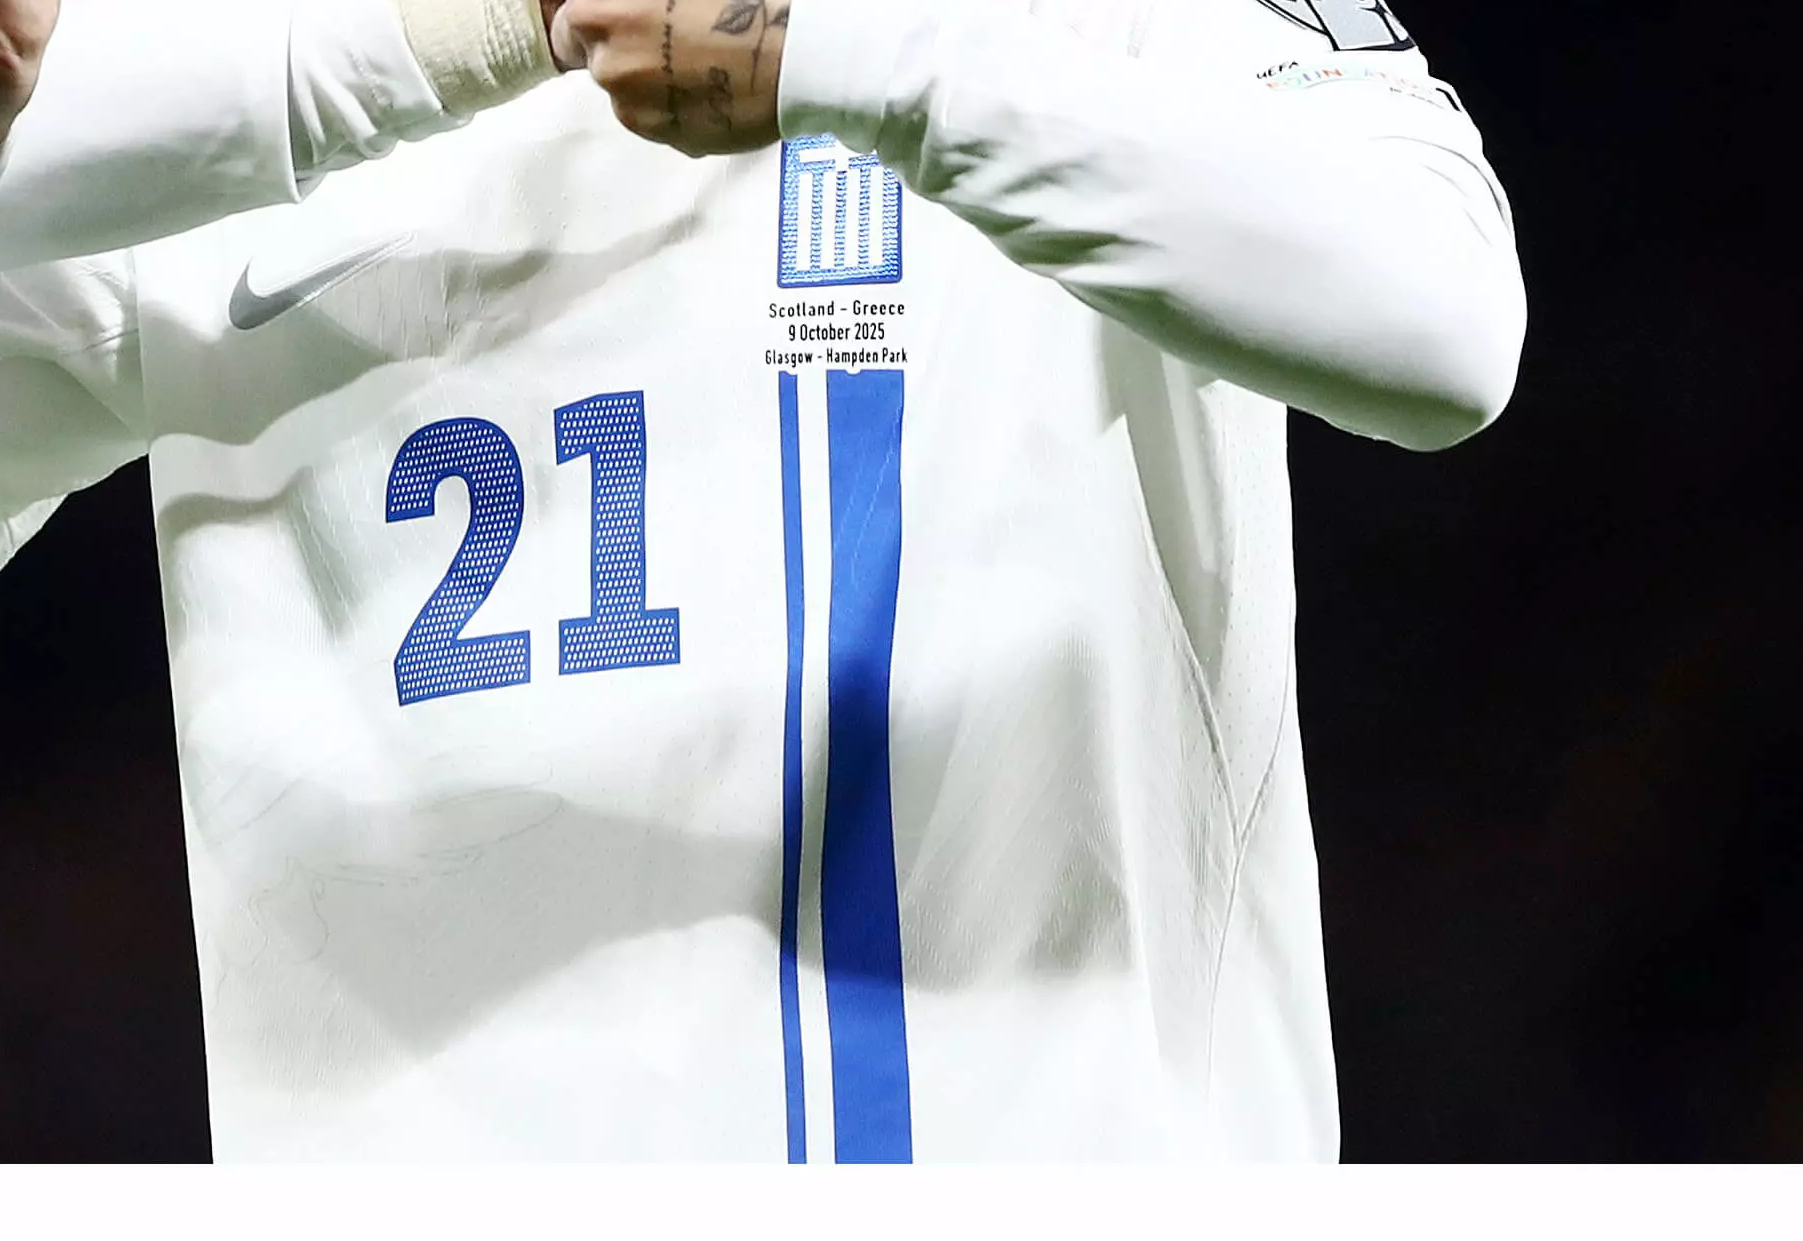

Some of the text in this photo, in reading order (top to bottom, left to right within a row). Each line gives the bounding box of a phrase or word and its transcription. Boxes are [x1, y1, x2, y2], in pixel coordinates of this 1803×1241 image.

[1256, 60, 1299, 80] UEFA
[769, 300, 835, 318] Scotland
[852, 299, 905, 316] Greece
[788, 322, 885, 341] 9 October 2025
[765, 349, 813, 368] Glasgow
[826, 347, 879, 367] Hampden
[882, 346, 908, 363] Park
[385, 389, 681, 707] 21
